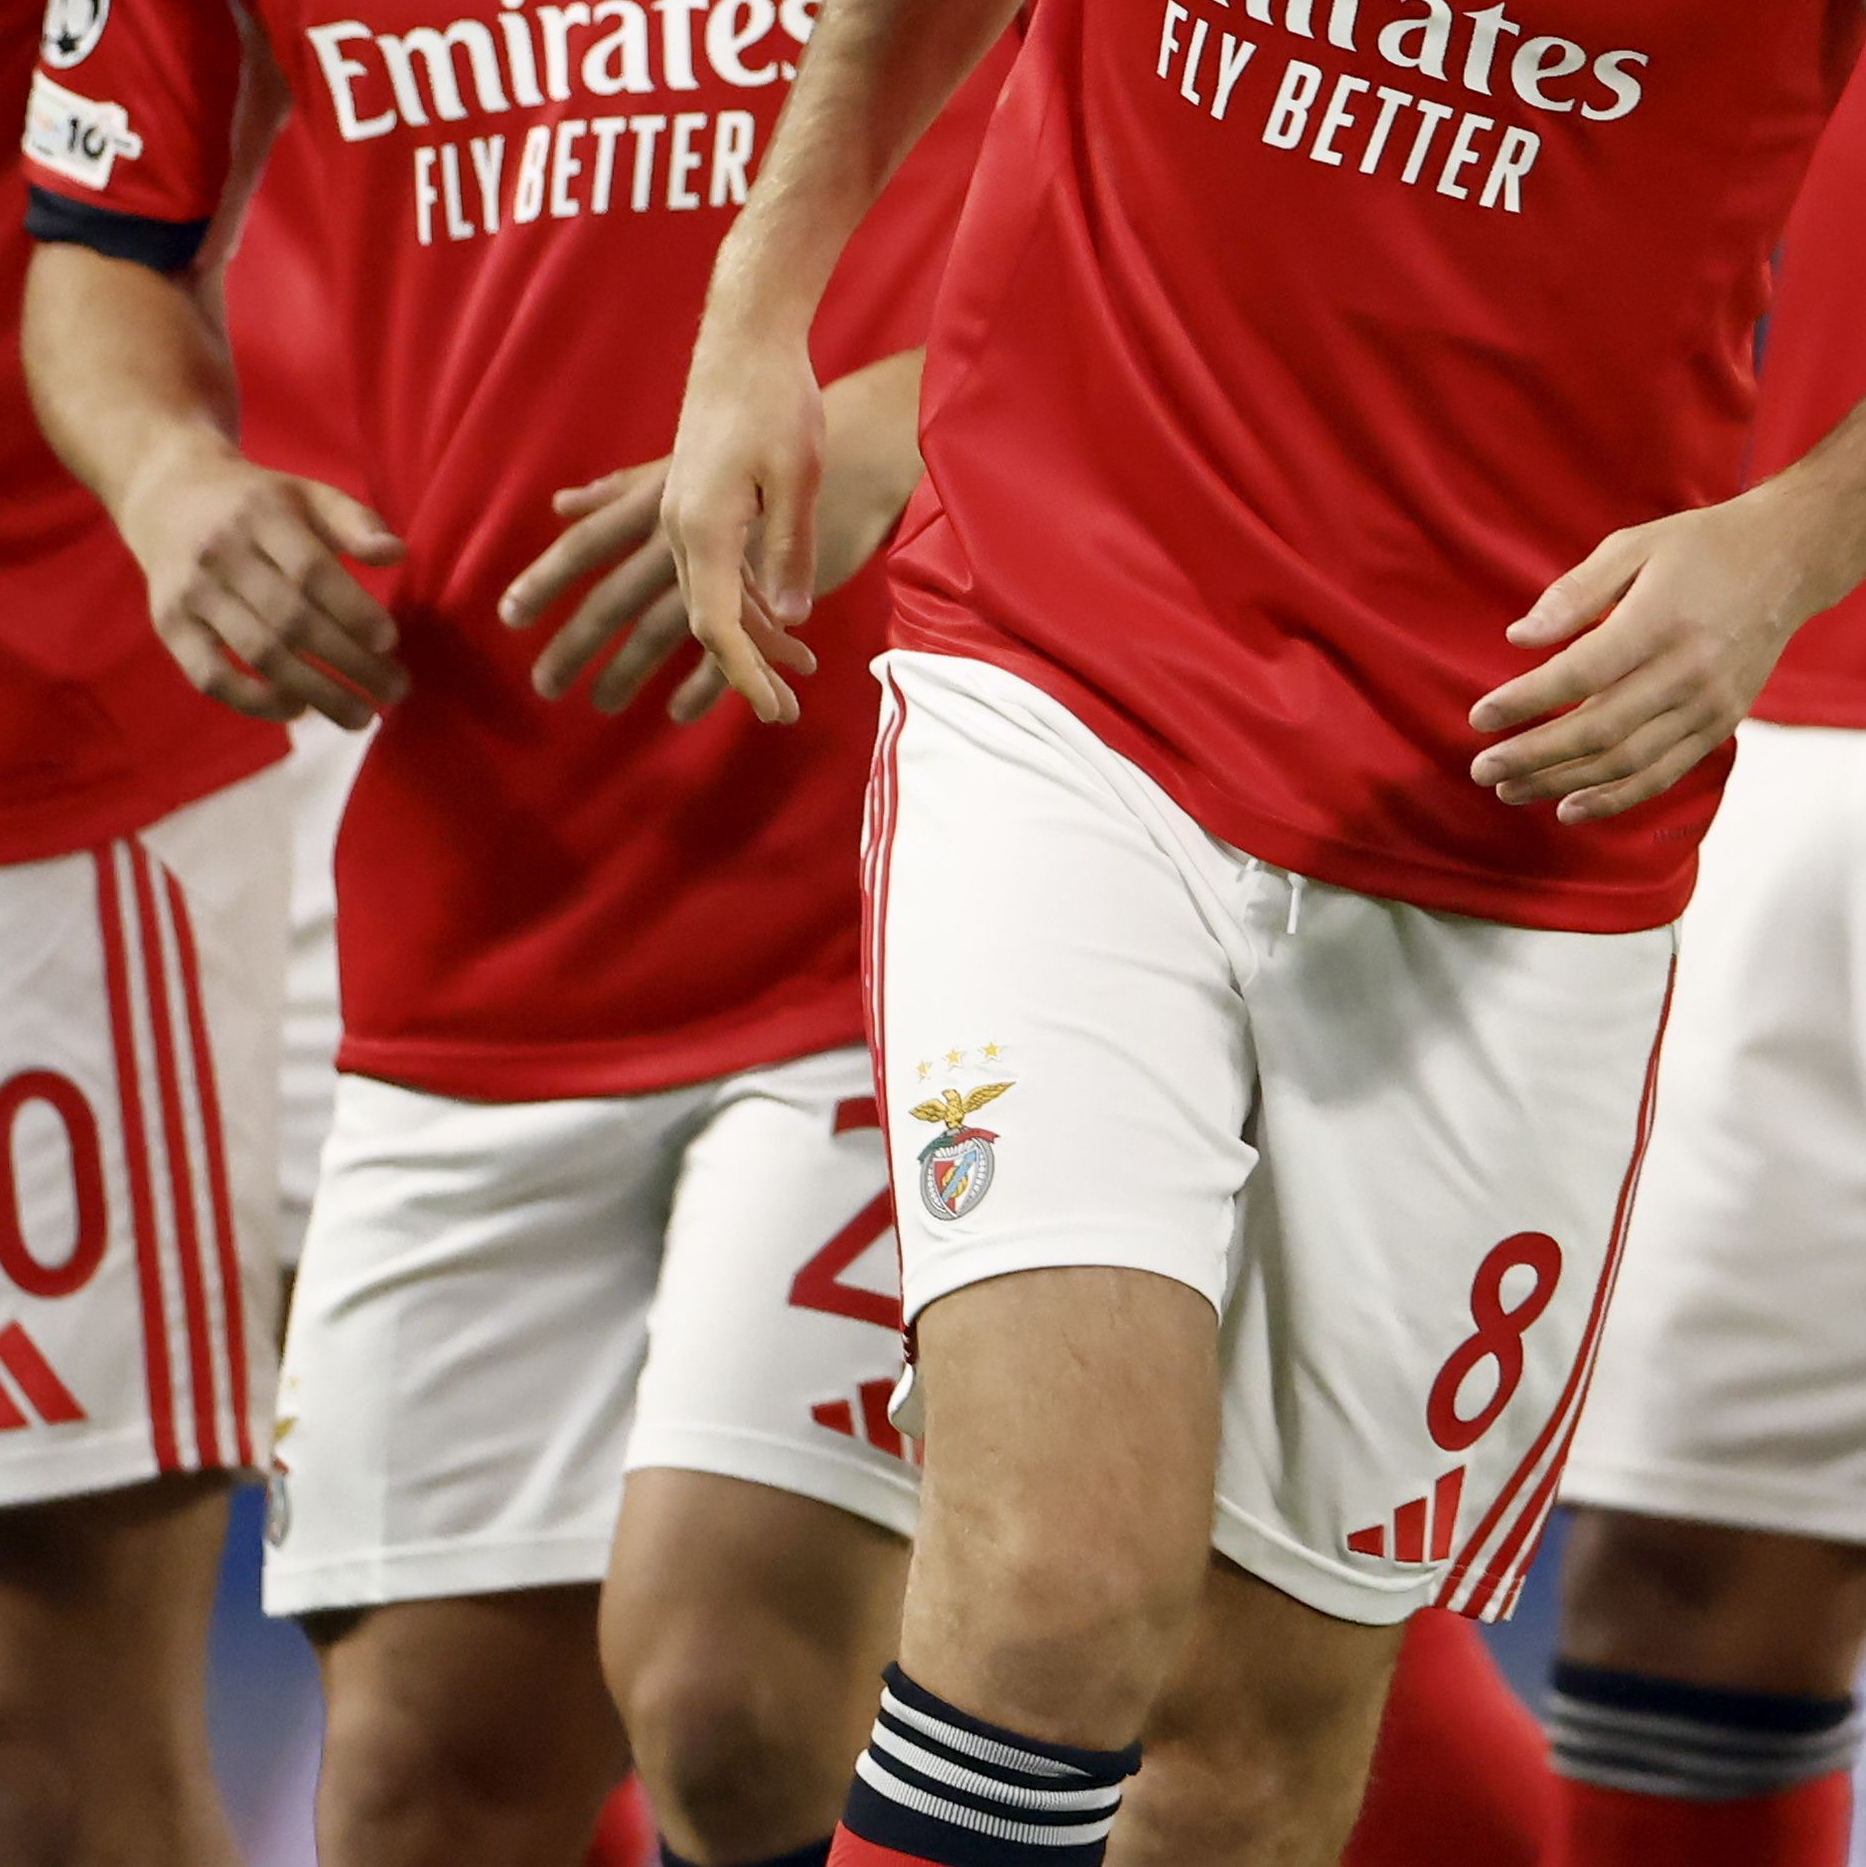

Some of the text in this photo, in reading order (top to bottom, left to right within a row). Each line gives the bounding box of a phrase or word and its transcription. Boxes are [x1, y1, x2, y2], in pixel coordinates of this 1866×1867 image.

[414, 110, 756, 247] FLY BETTER
[1261, 58, 1541, 214] BETTER
[1427, 1231, 1563, 1453] 8
